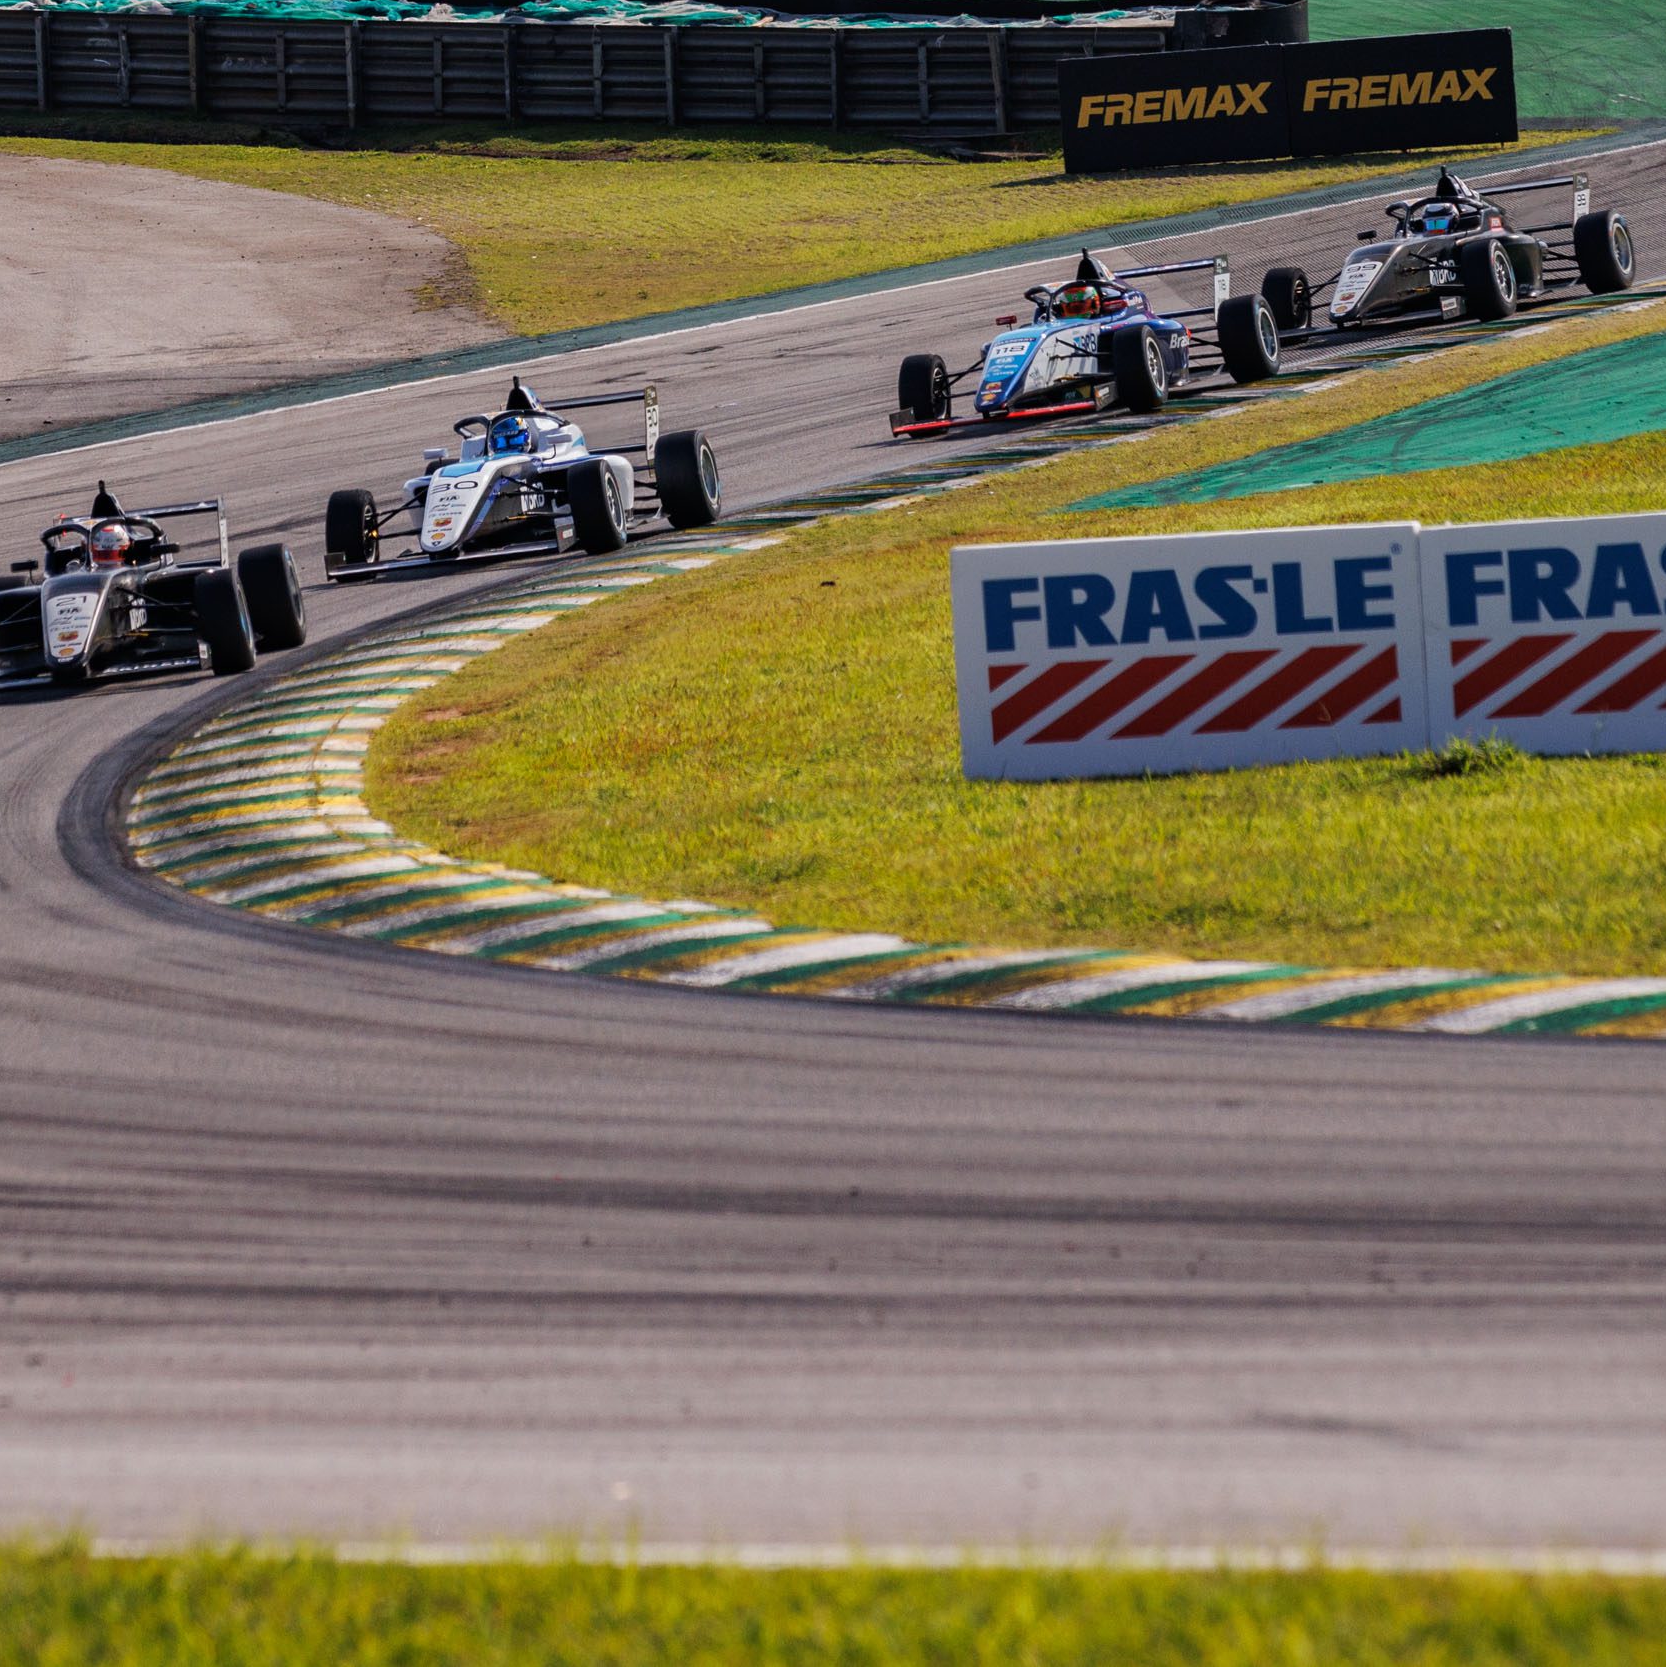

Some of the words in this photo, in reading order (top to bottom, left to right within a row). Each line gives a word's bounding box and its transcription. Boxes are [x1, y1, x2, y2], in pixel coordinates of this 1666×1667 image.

[1303, 67, 1497, 112] FREMAX
[1077, 81, 1273, 129] FREMAX
[429, 480, 479, 496] 30
[55, 595, 88, 607] 21
